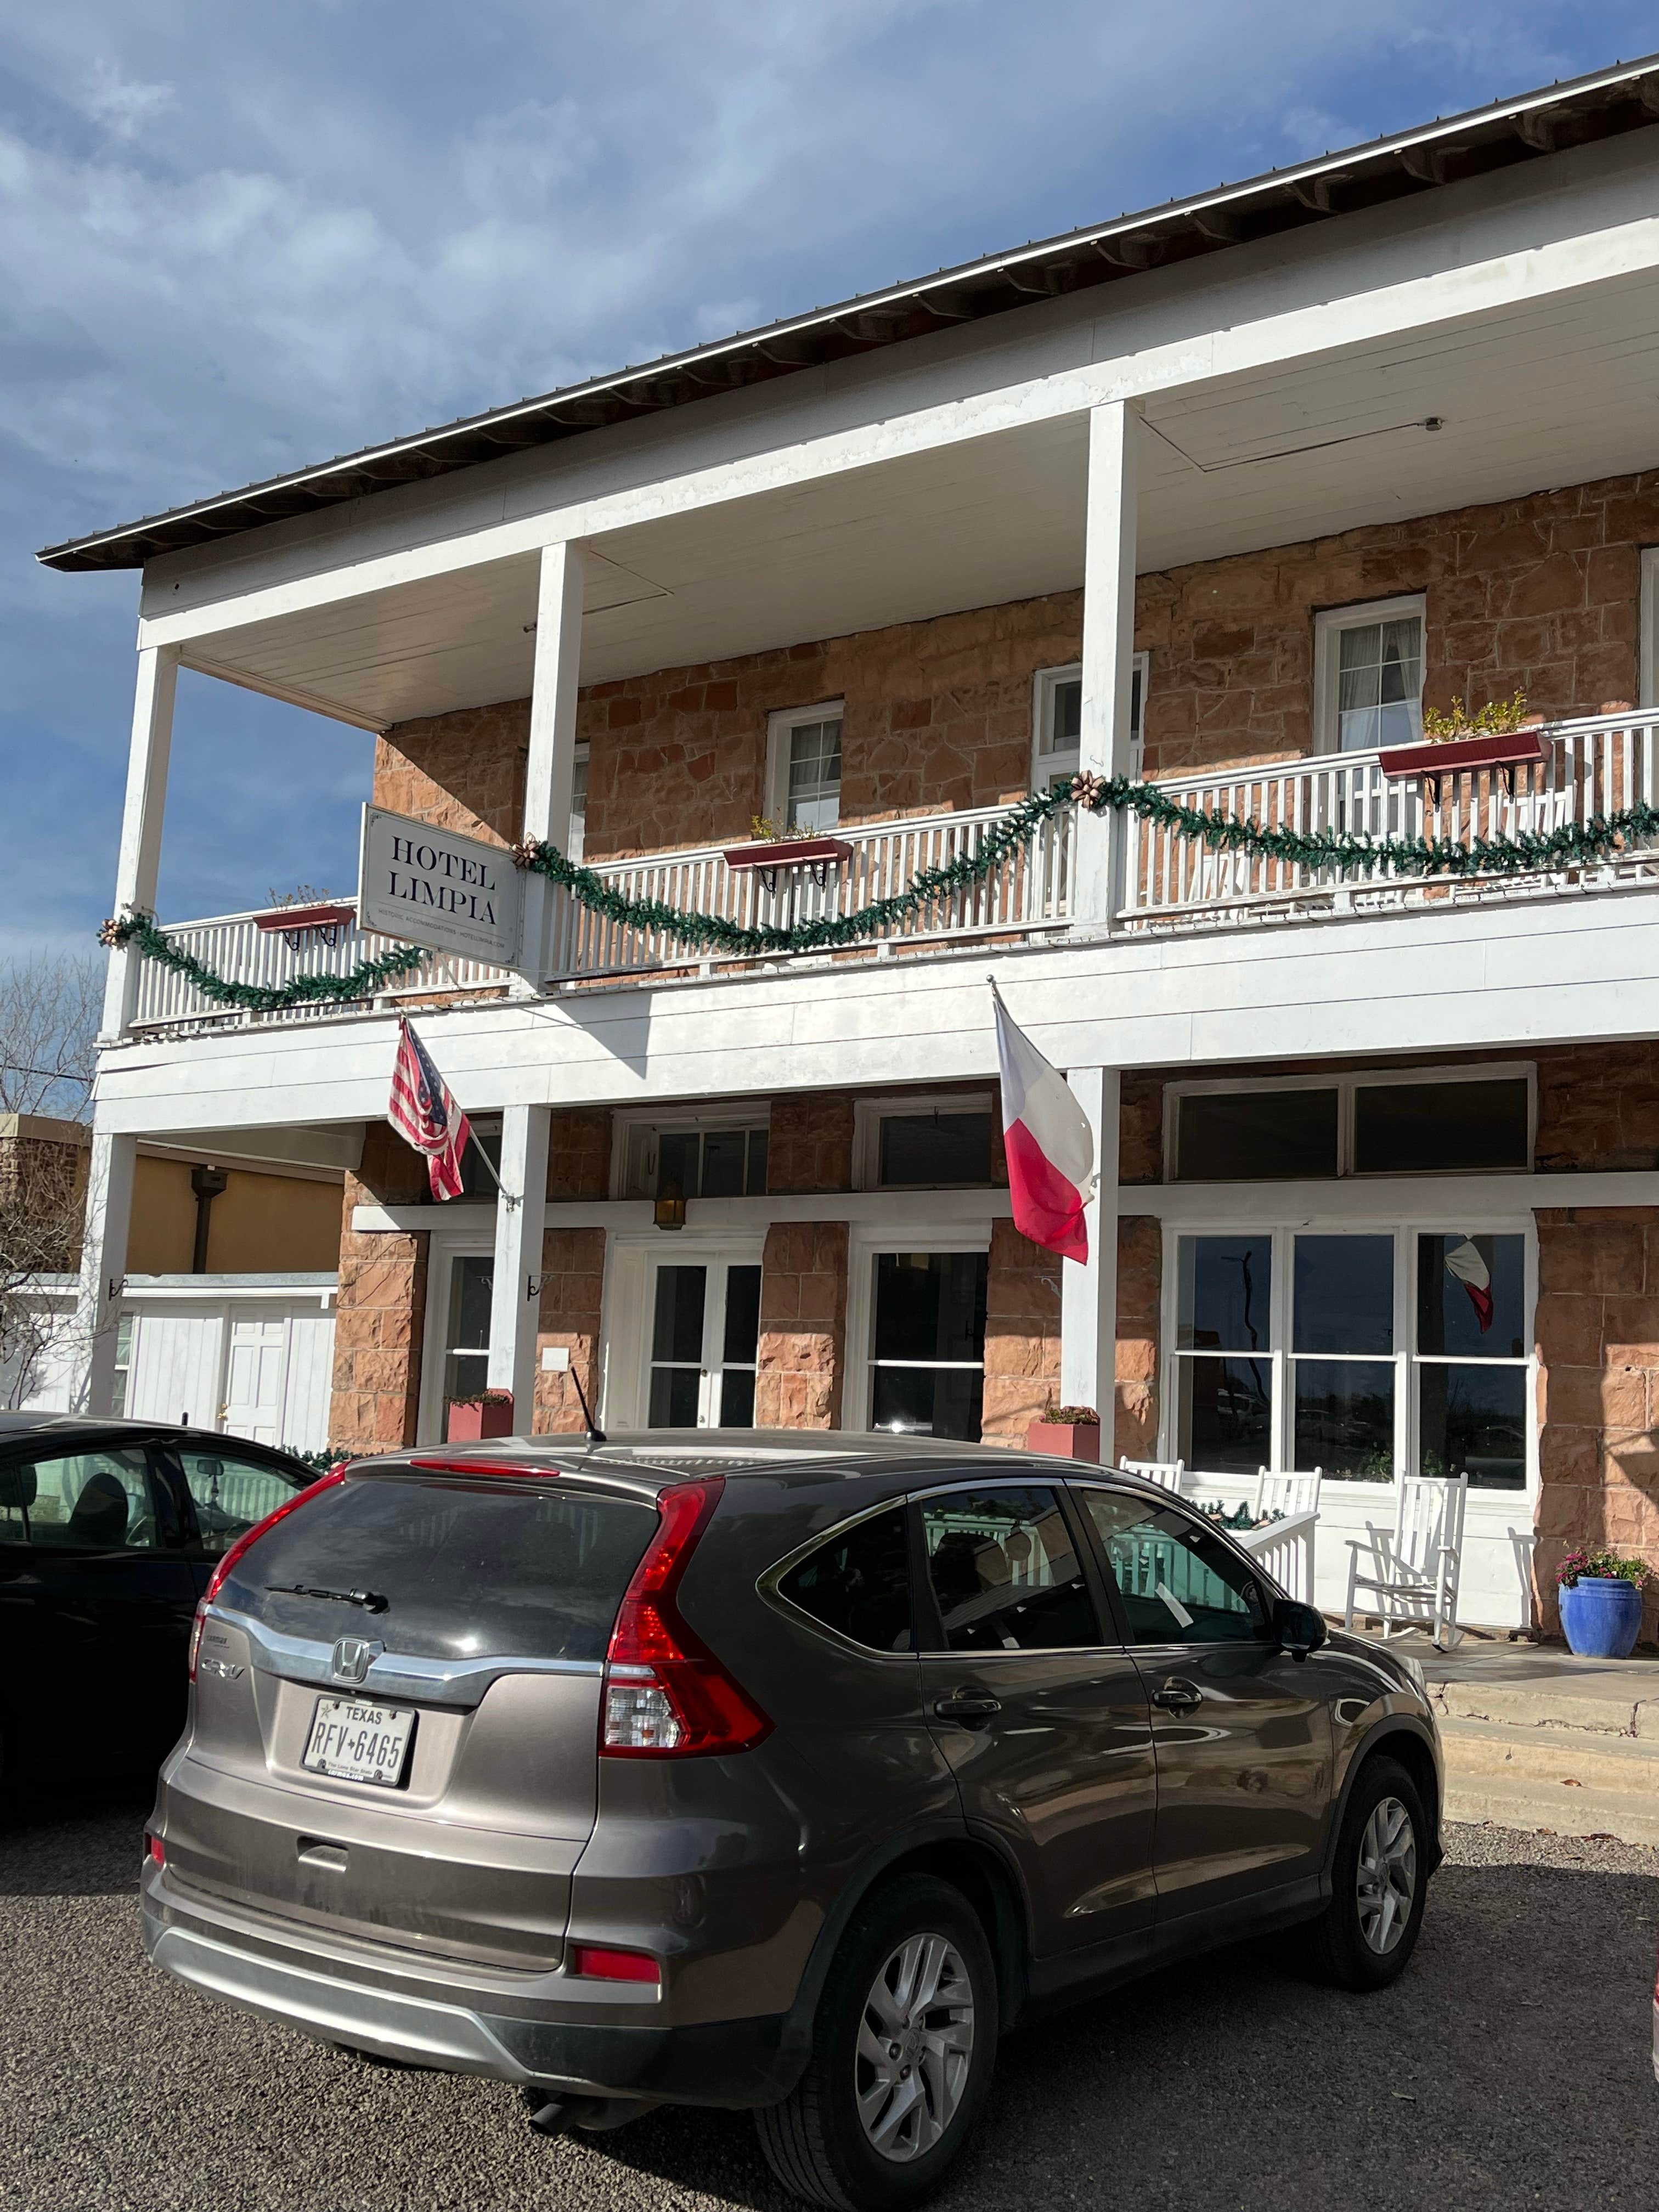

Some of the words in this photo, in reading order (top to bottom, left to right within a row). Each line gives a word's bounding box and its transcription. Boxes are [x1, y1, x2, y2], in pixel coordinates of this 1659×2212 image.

[391, 835, 495, 891] HOTEL
[378, 909, 403, 921] HISTORIC
[387, 870, 496, 925] LIMPIA
[346, 1706, 382, 1725] TEXAS
